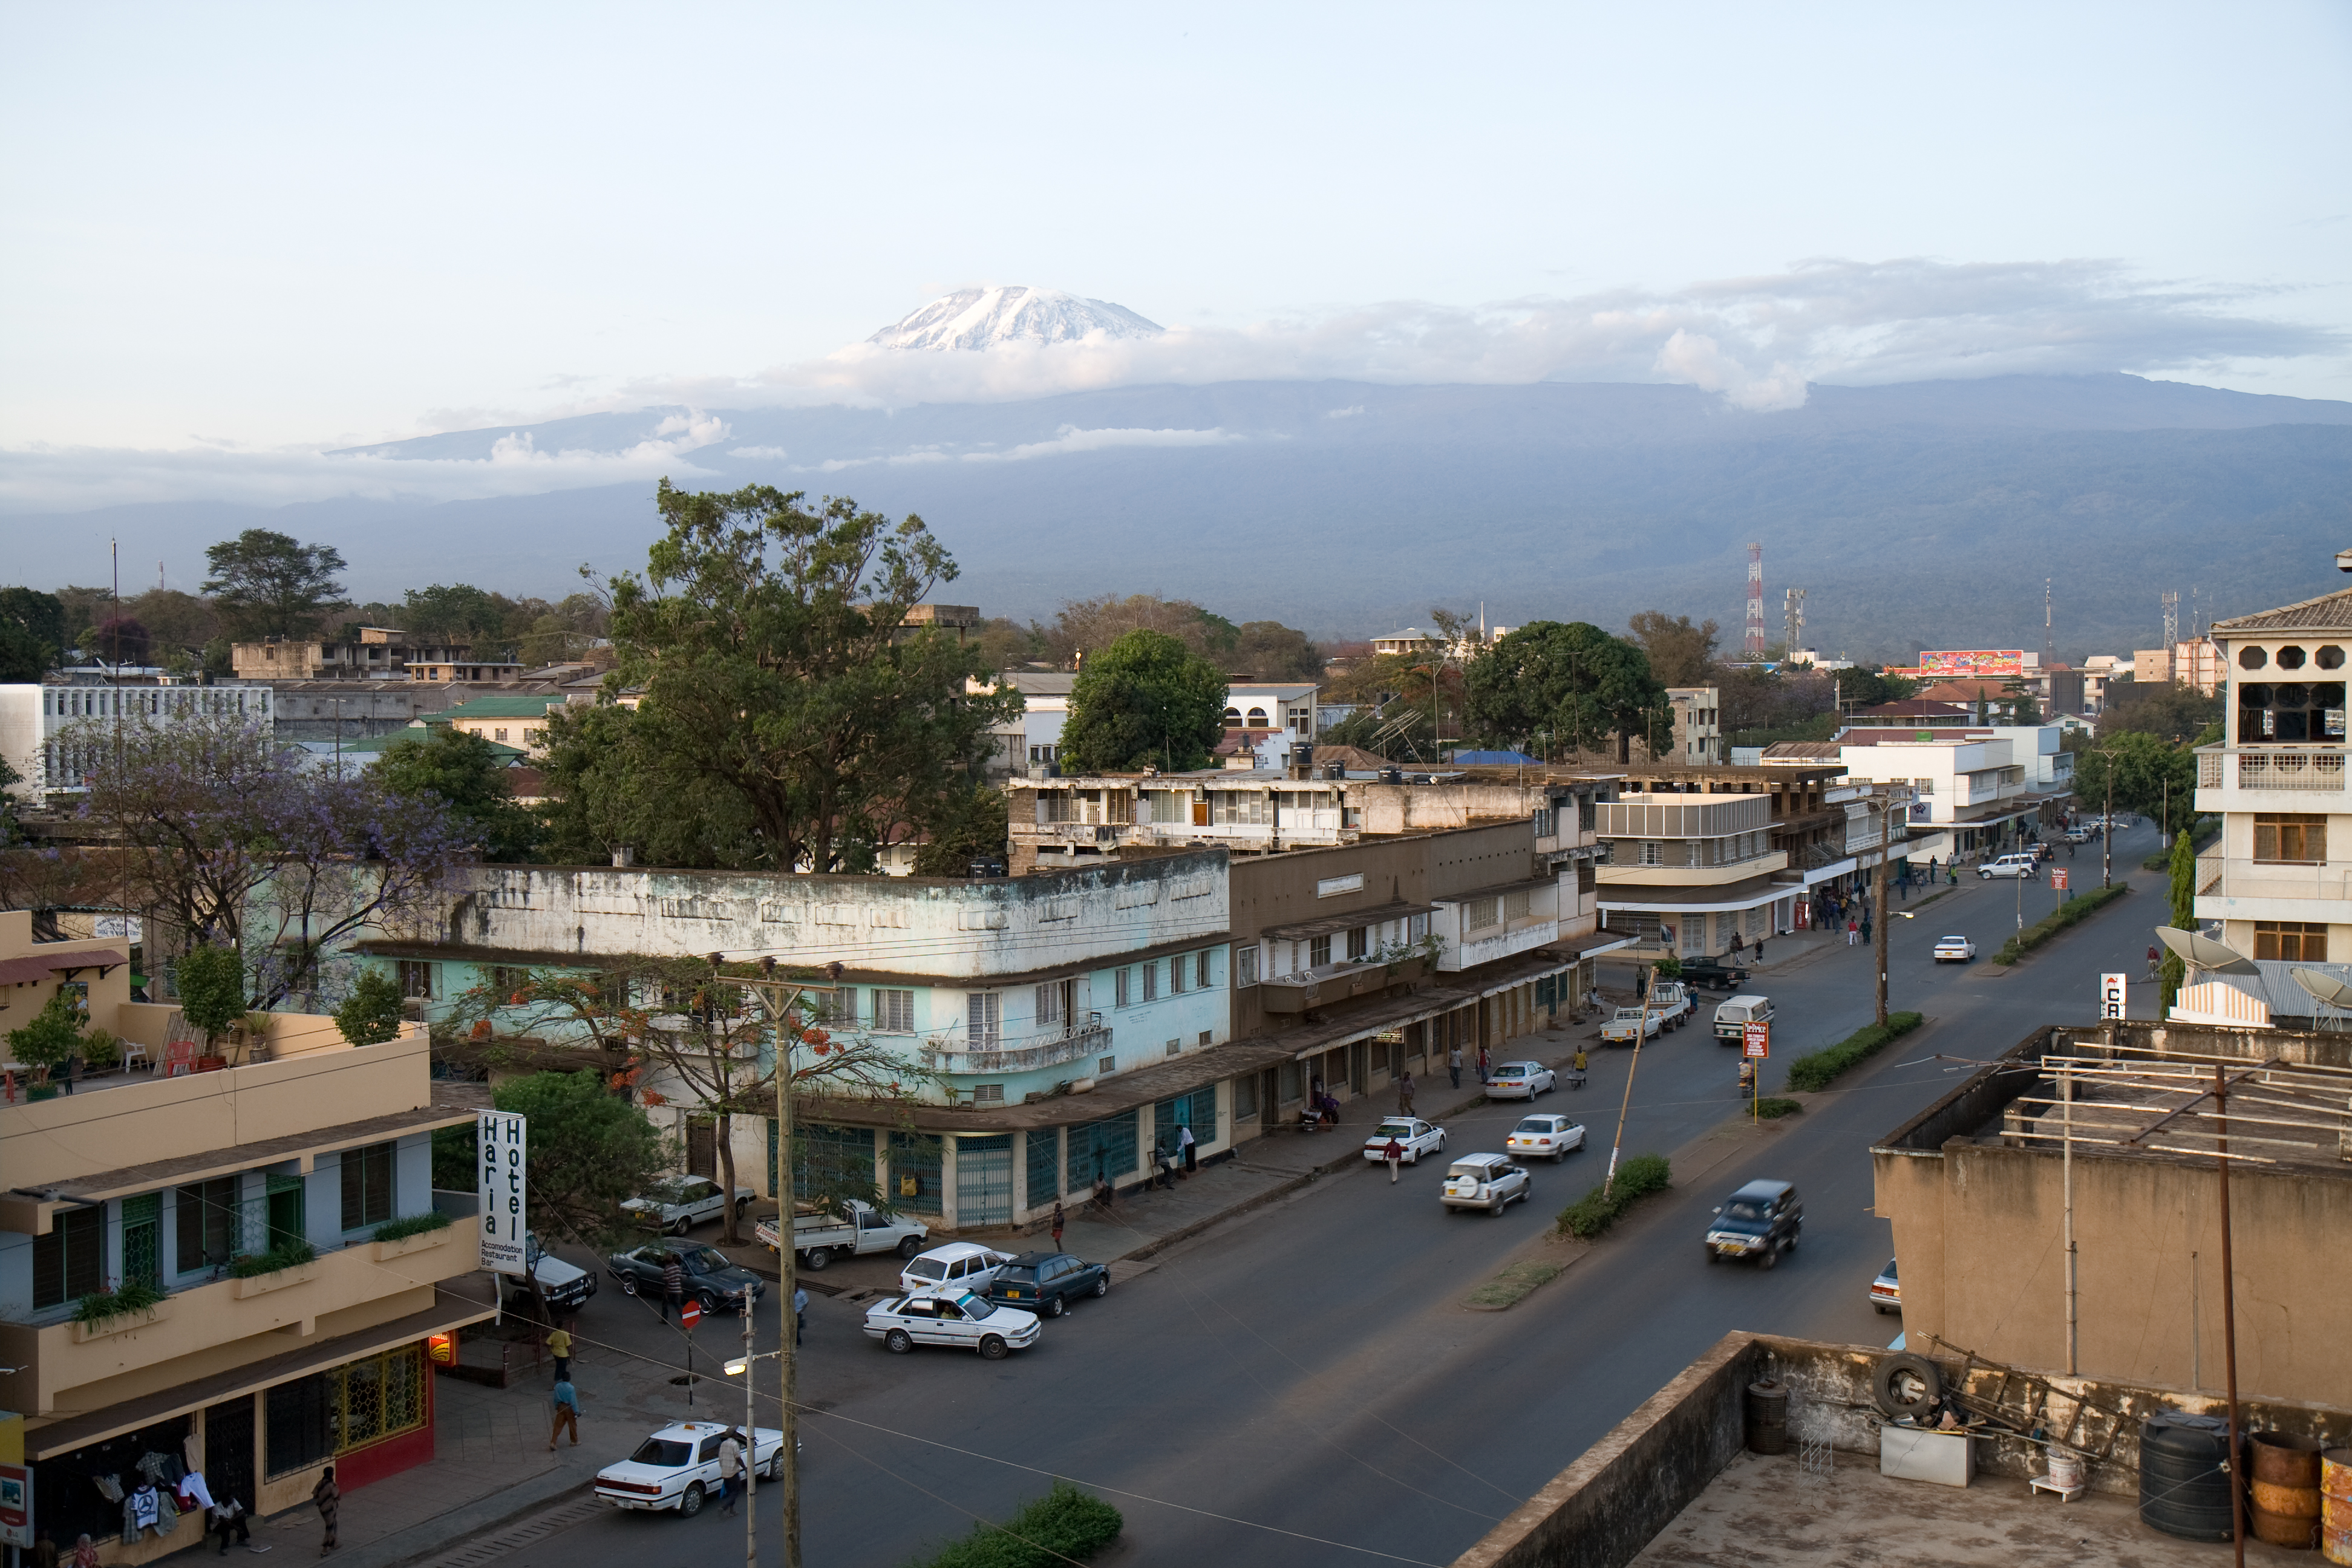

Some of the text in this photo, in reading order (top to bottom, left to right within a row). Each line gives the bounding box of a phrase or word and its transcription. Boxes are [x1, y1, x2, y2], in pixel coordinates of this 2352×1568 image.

[485, 1116, 497, 1235] Haria
[507, 1119, 520, 1241] Hotel
[762, 1229, 778, 1241] TOYOTA
[482, 1240, 523, 1255] Accomodation
[481, 1248, 517, 1262] Restaurant
[481, 1257, 494, 1266] Bar
